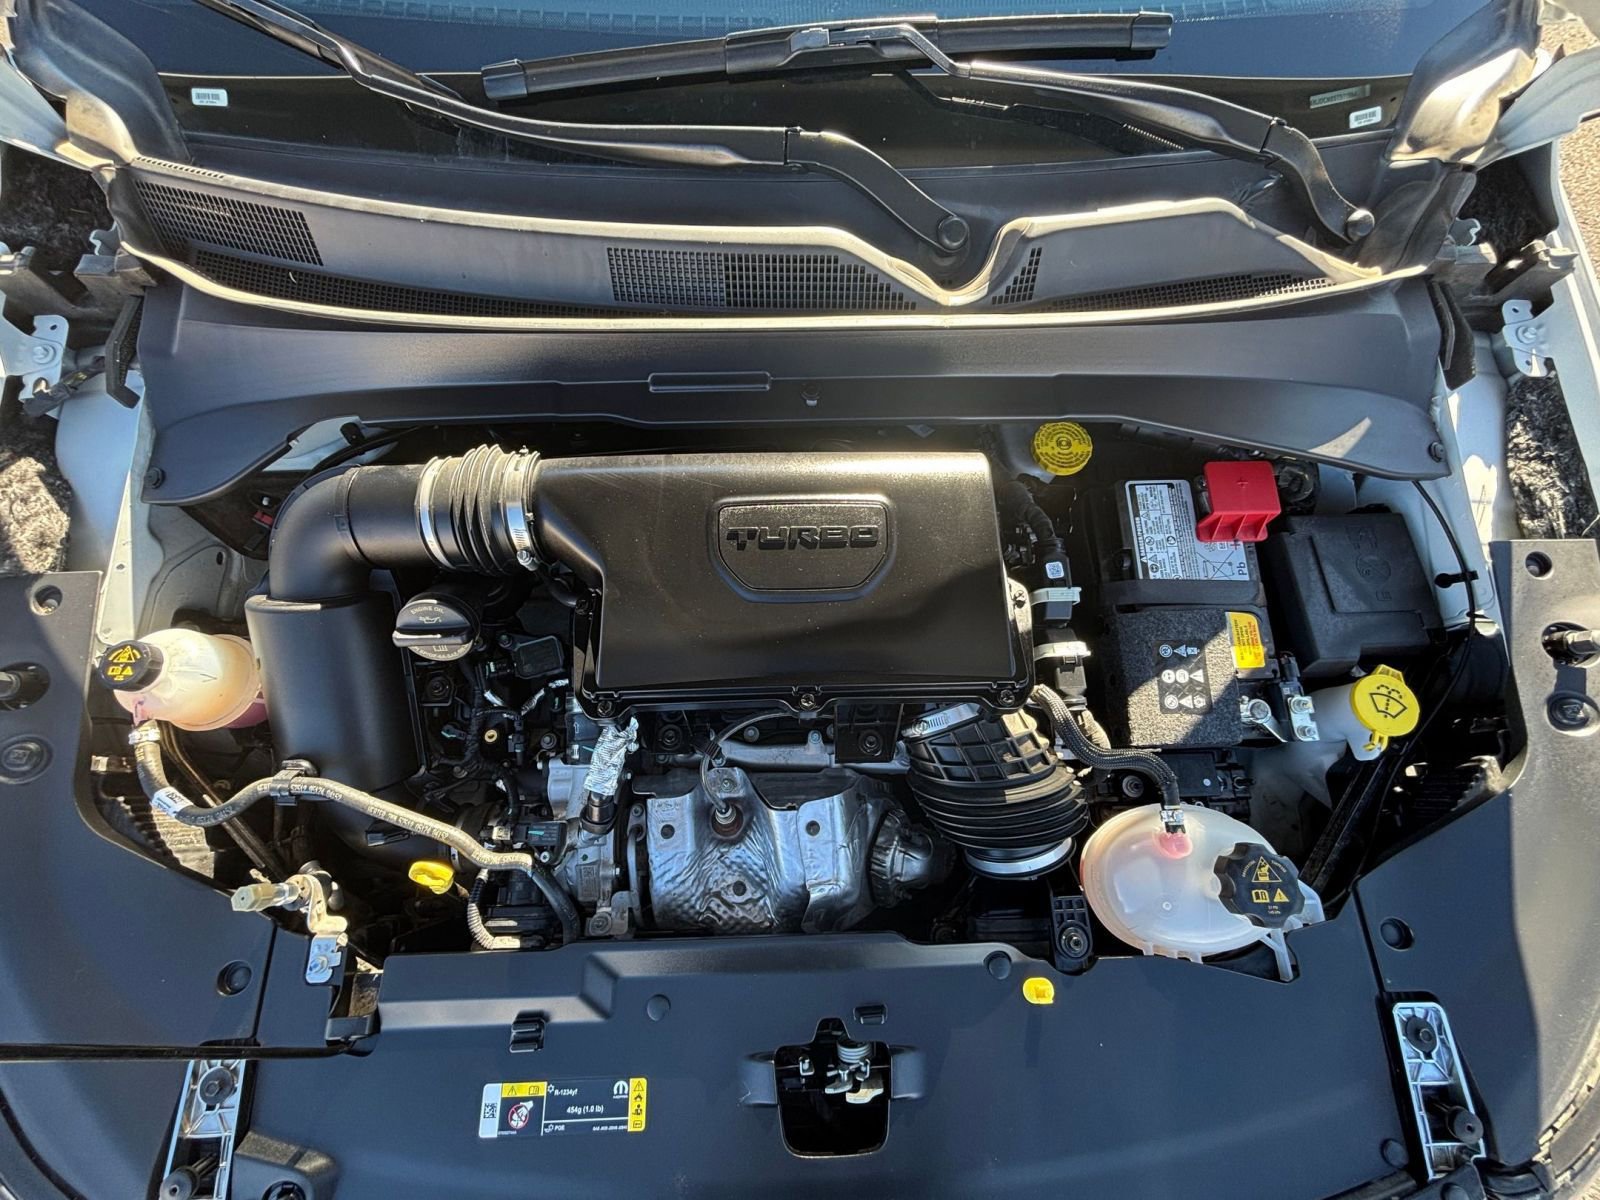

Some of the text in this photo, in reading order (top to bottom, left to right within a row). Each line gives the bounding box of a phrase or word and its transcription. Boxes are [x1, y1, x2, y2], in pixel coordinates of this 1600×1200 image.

[726, 525, 879, 551] TURBO
[1236, 562, 1248, 576] Pb
[410, 606, 444, 614] ENGINE OIL
[554, 1088, 578, 1097] R-1234yf
[567, 1104, 604, 1115] 454g (1.0 lb)
